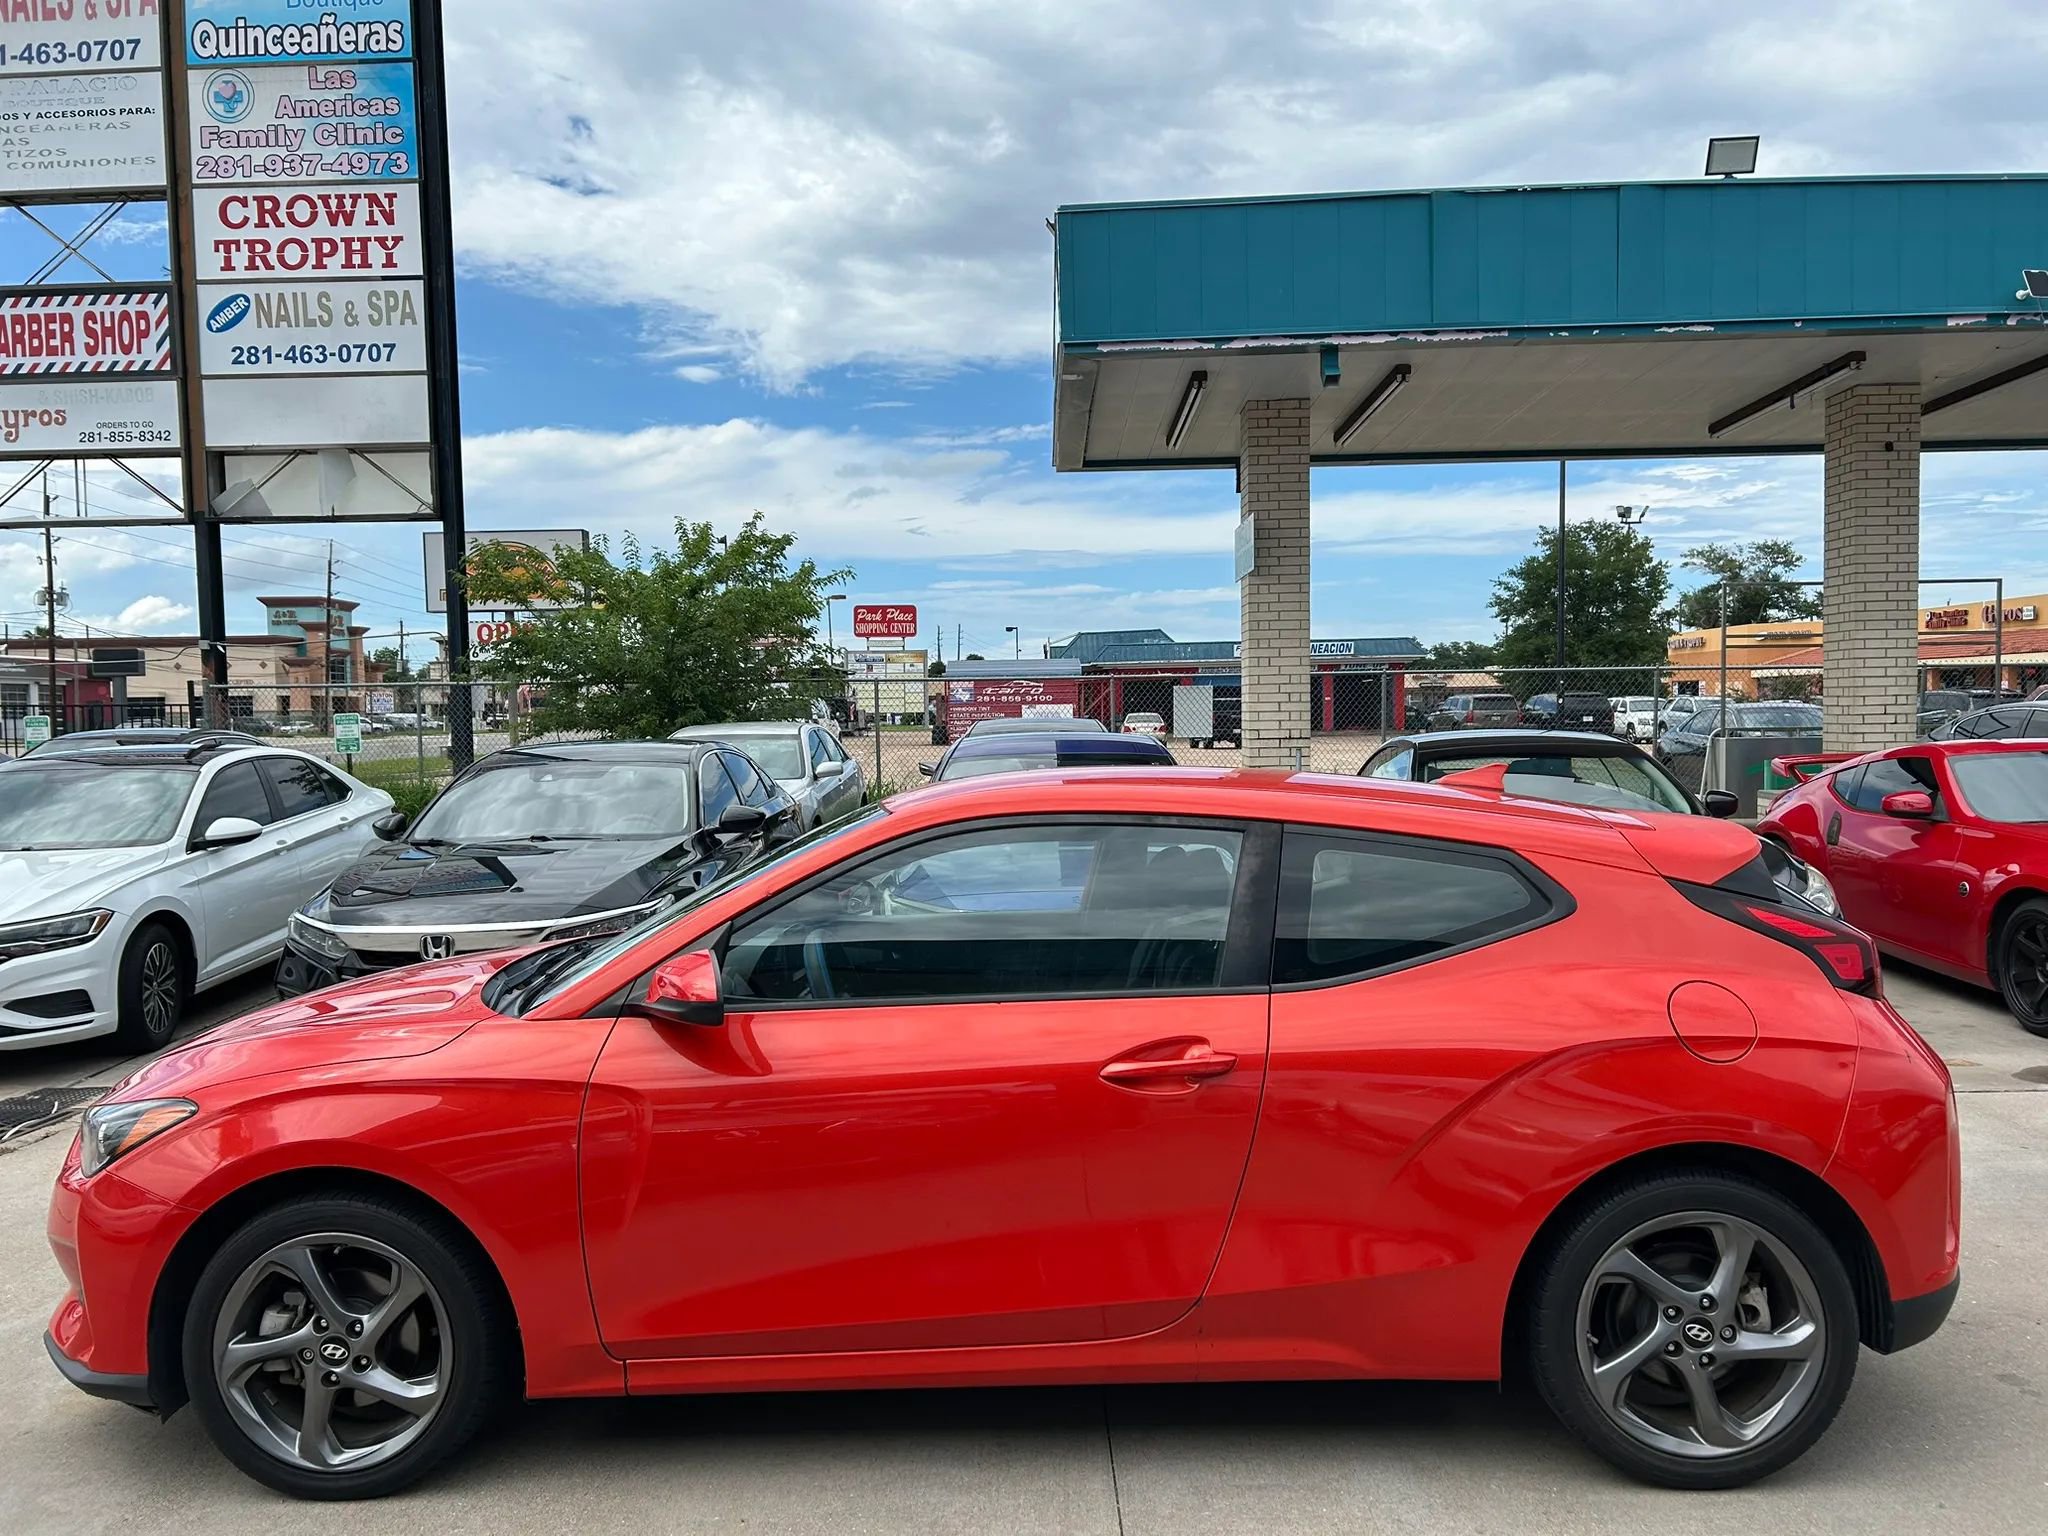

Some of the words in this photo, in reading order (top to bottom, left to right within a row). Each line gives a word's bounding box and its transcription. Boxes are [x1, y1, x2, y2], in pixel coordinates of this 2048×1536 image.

[192, 12, 404, 58] Quinceañeras
[308, 66, 356, 90] Las
[0, 113, 19, 121] OS
[23, 112, 31, 120] Y
[36, 108, 116, 119] ACCESORIOS
[119, 107, 156, 116] PARA:
[275, 94, 400, 118] Americas
[200, 124, 305, 151] Family
[313, 122, 404, 146] Clinic
[7, 156, 156, 171] COMUNIONES
[197, 152, 409, 179] 281-937-4973
[218, 192, 398, 229] CROWN
[213, 236, 404, 272] TROPHY
[209, 296, 249, 332] AMBER
[254, 291, 333, 328] NAILS
[344, 299, 360, 327] &
[367, 289, 417, 327] SPA
[83, 309, 150, 356] SHOP
[231, 343, 397, 365] 281-463-0707
[0, 408, 67, 444] yros
[79, 430, 171, 443] 281-855-8342
[96, 421, 128, 430] ORDERS
[142, 420, 153, 428] GO
[857, 608, 883, 621] Park
[886, 608, 914, 621] Place
[855, 622, 888, 634] SHOPPING
[890, 622, 915, 633] CENTER
